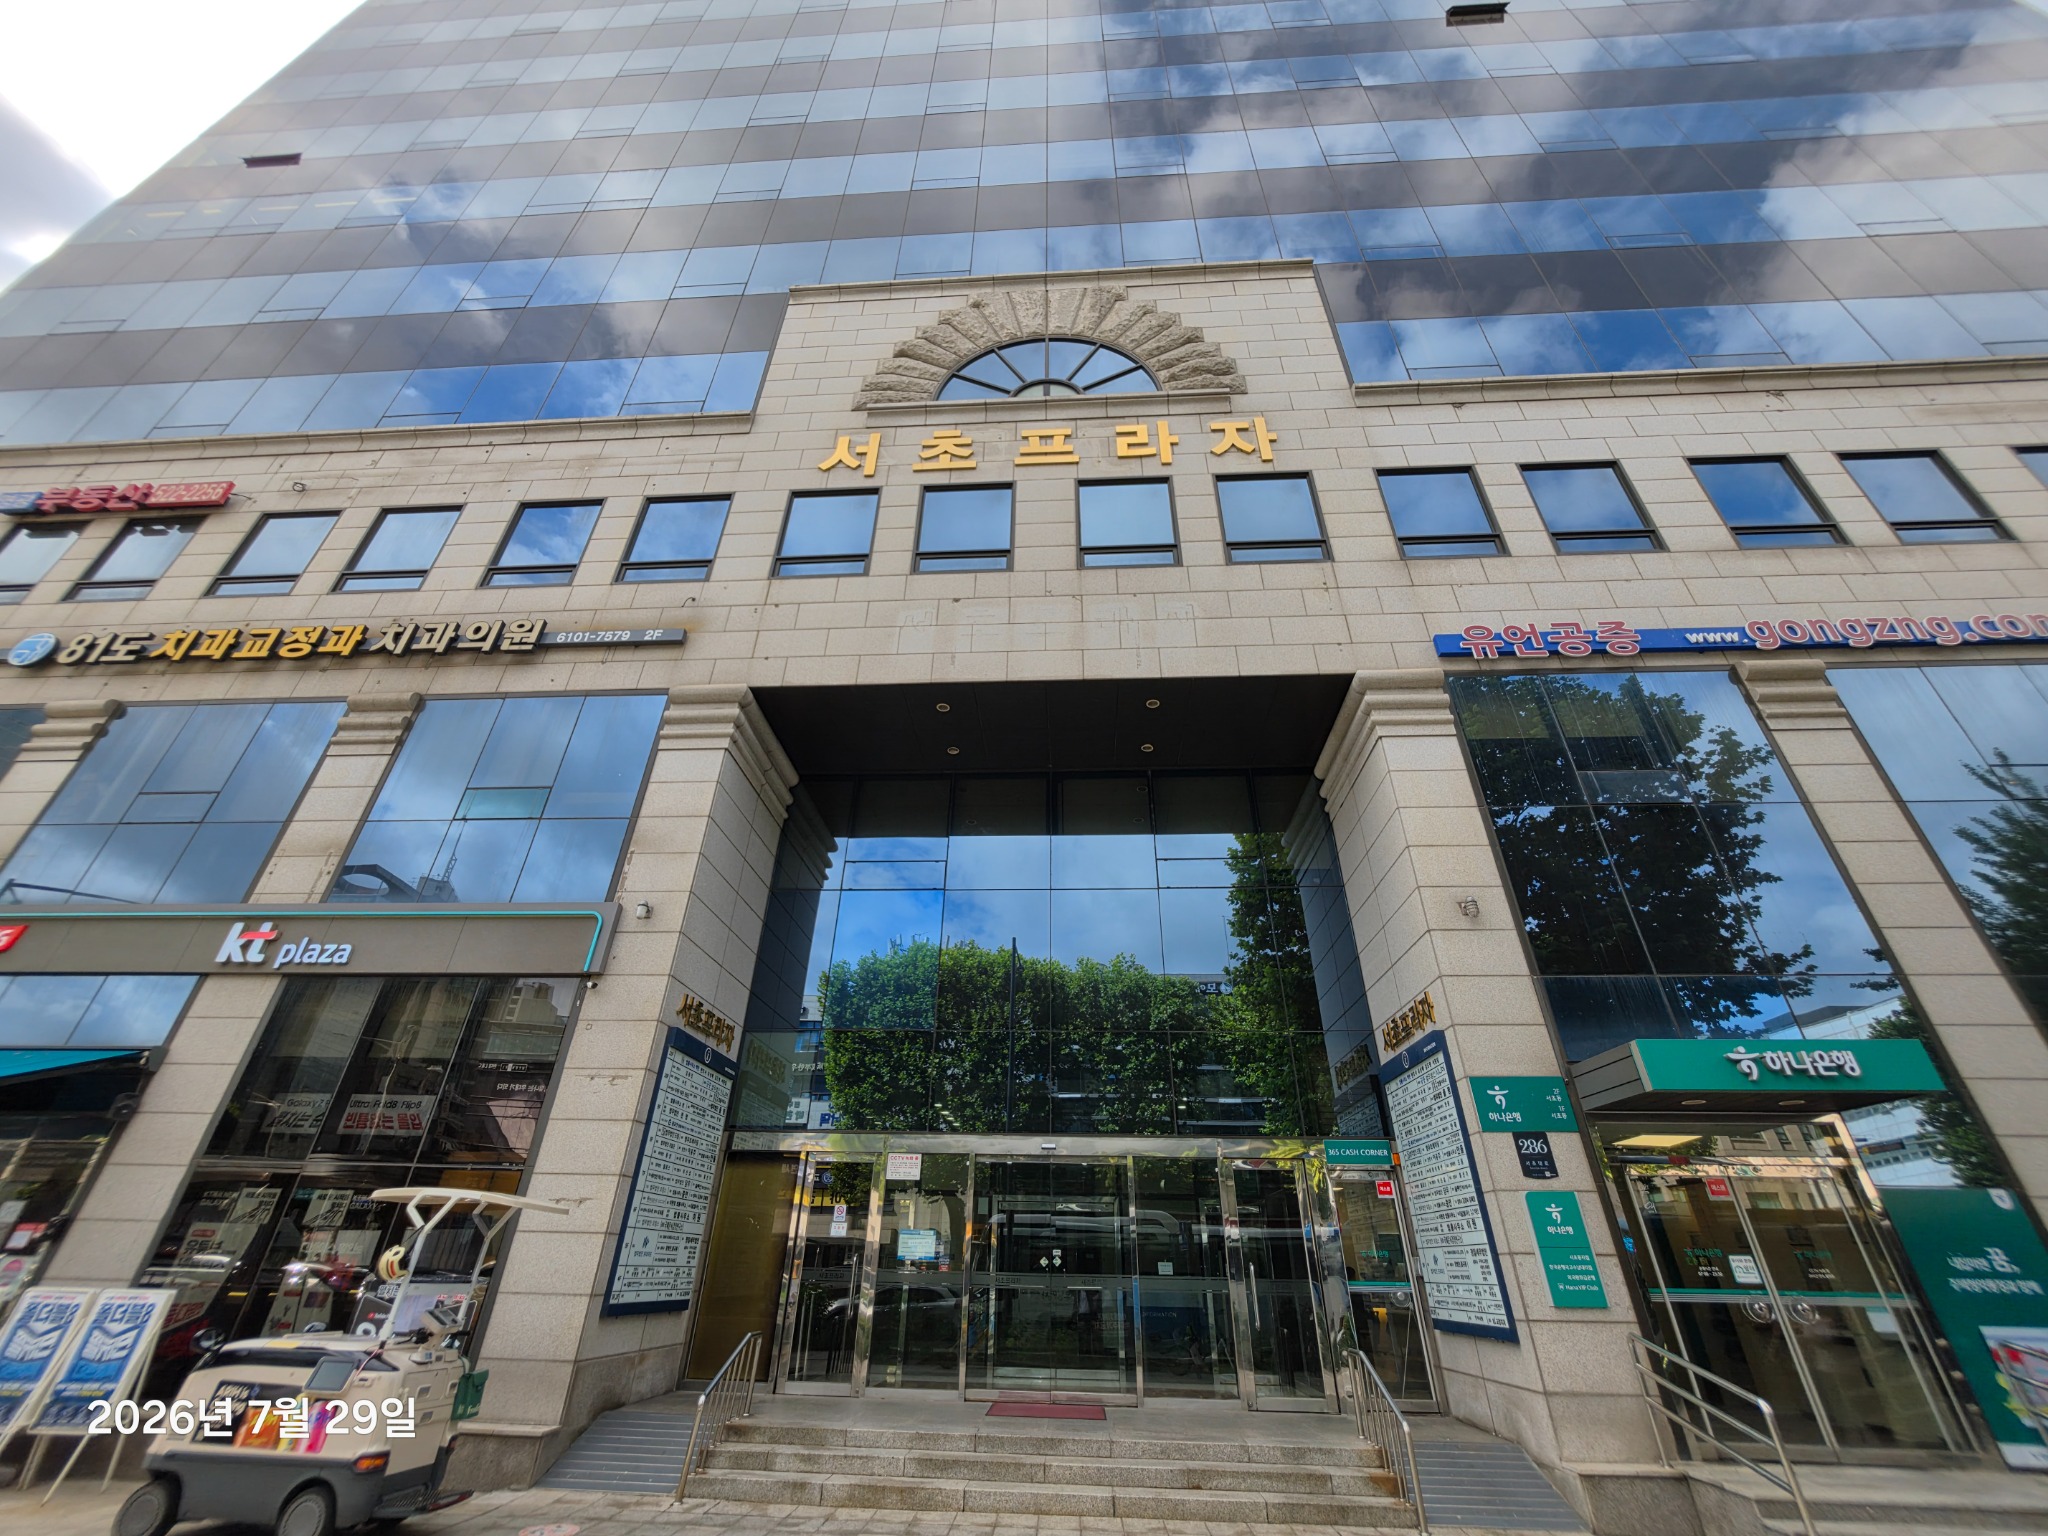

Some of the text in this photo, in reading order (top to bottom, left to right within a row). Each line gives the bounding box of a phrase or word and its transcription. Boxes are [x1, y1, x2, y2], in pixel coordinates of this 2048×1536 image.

[818, 417, 1277, 477] 서초프라자
[36, 483, 153, 513] 부동산
[57, 618, 664, 664] 81도 치과교정과 치과의원 6101-7579 2F
[1460, 622, 1640, 658] 유언공증
[215, 922, 352, 968] kt plaza
[675, 993, 735, 1052] 서초프라자
[1382, 991, 1436, 1052] 서초프라자
[1763, 1049, 1862, 1078] 하나은행
[400, 1100, 422, 1110] Flip8
[1488, 1112, 1521, 1122] 하나은행
[1328, 1148, 1389, 1157] 365 CASH CORNER
[1518, 1138, 1548, 1154] 286
[1547, 1226, 1574, 1235] 하나은행
